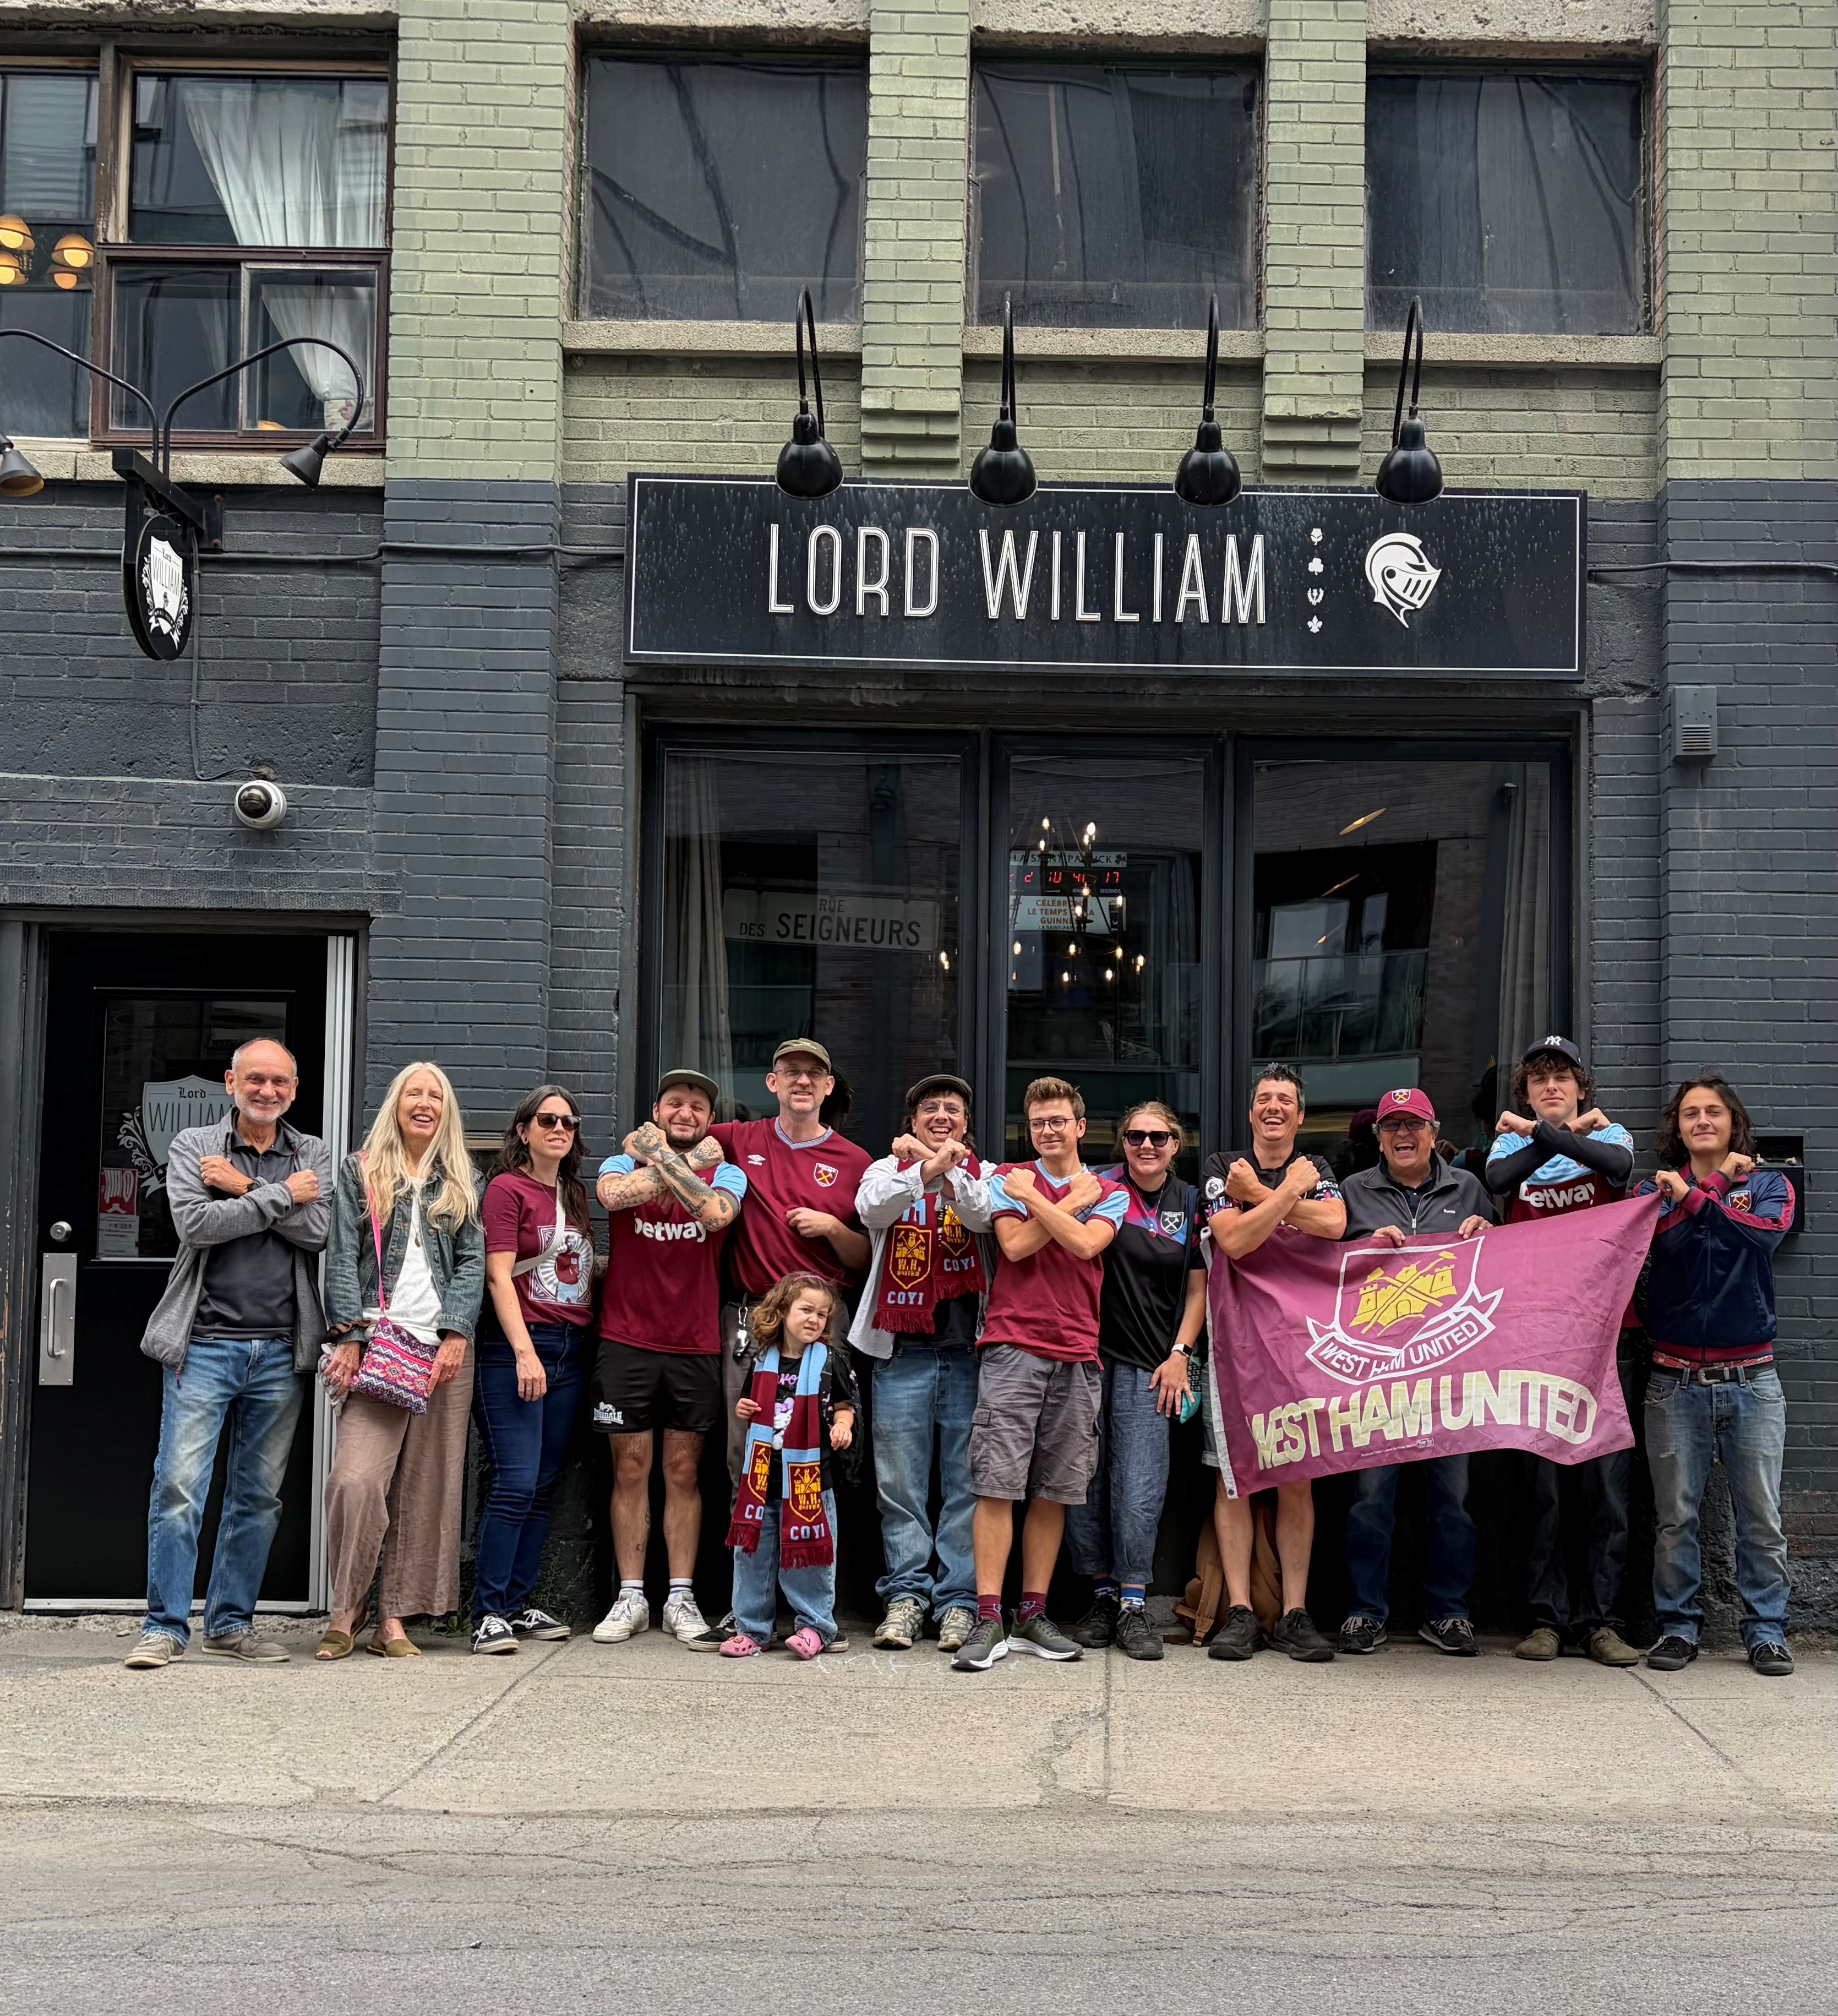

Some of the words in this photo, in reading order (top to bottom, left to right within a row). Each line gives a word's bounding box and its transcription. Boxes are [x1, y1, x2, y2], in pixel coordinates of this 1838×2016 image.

[768, 524, 939, 617] LORD
[979, 529, 1266, 624] WILLIAM
[1031, 854, 1062, 863] SNT
[1068, 855, 1112, 863] PACK
[1106, 871, 1120, 884] 17
[819, 898, 846, 913] RUE
[739, 922, 765, 937] DES
[776, 912, 921, 947] SEIGNEURS
[1544, 1036, 1562, 1046] NY
[177, 1087, 206, 1099] Lord
[943, 1255, 976, 1272] COYI
[887, 1290, 924, 1305] COYI
[1319, 1341, 1371, 1377] WEST
[1409, 1320, 1479, 1365] UNITED
[1246, 1397, 1326, 1470] WEST
[1329, 1378, 1432, 1452] HAM
[1439, 1369, 1598, 1445] UNITED
[790, 1523, 825, 1541] COYI
